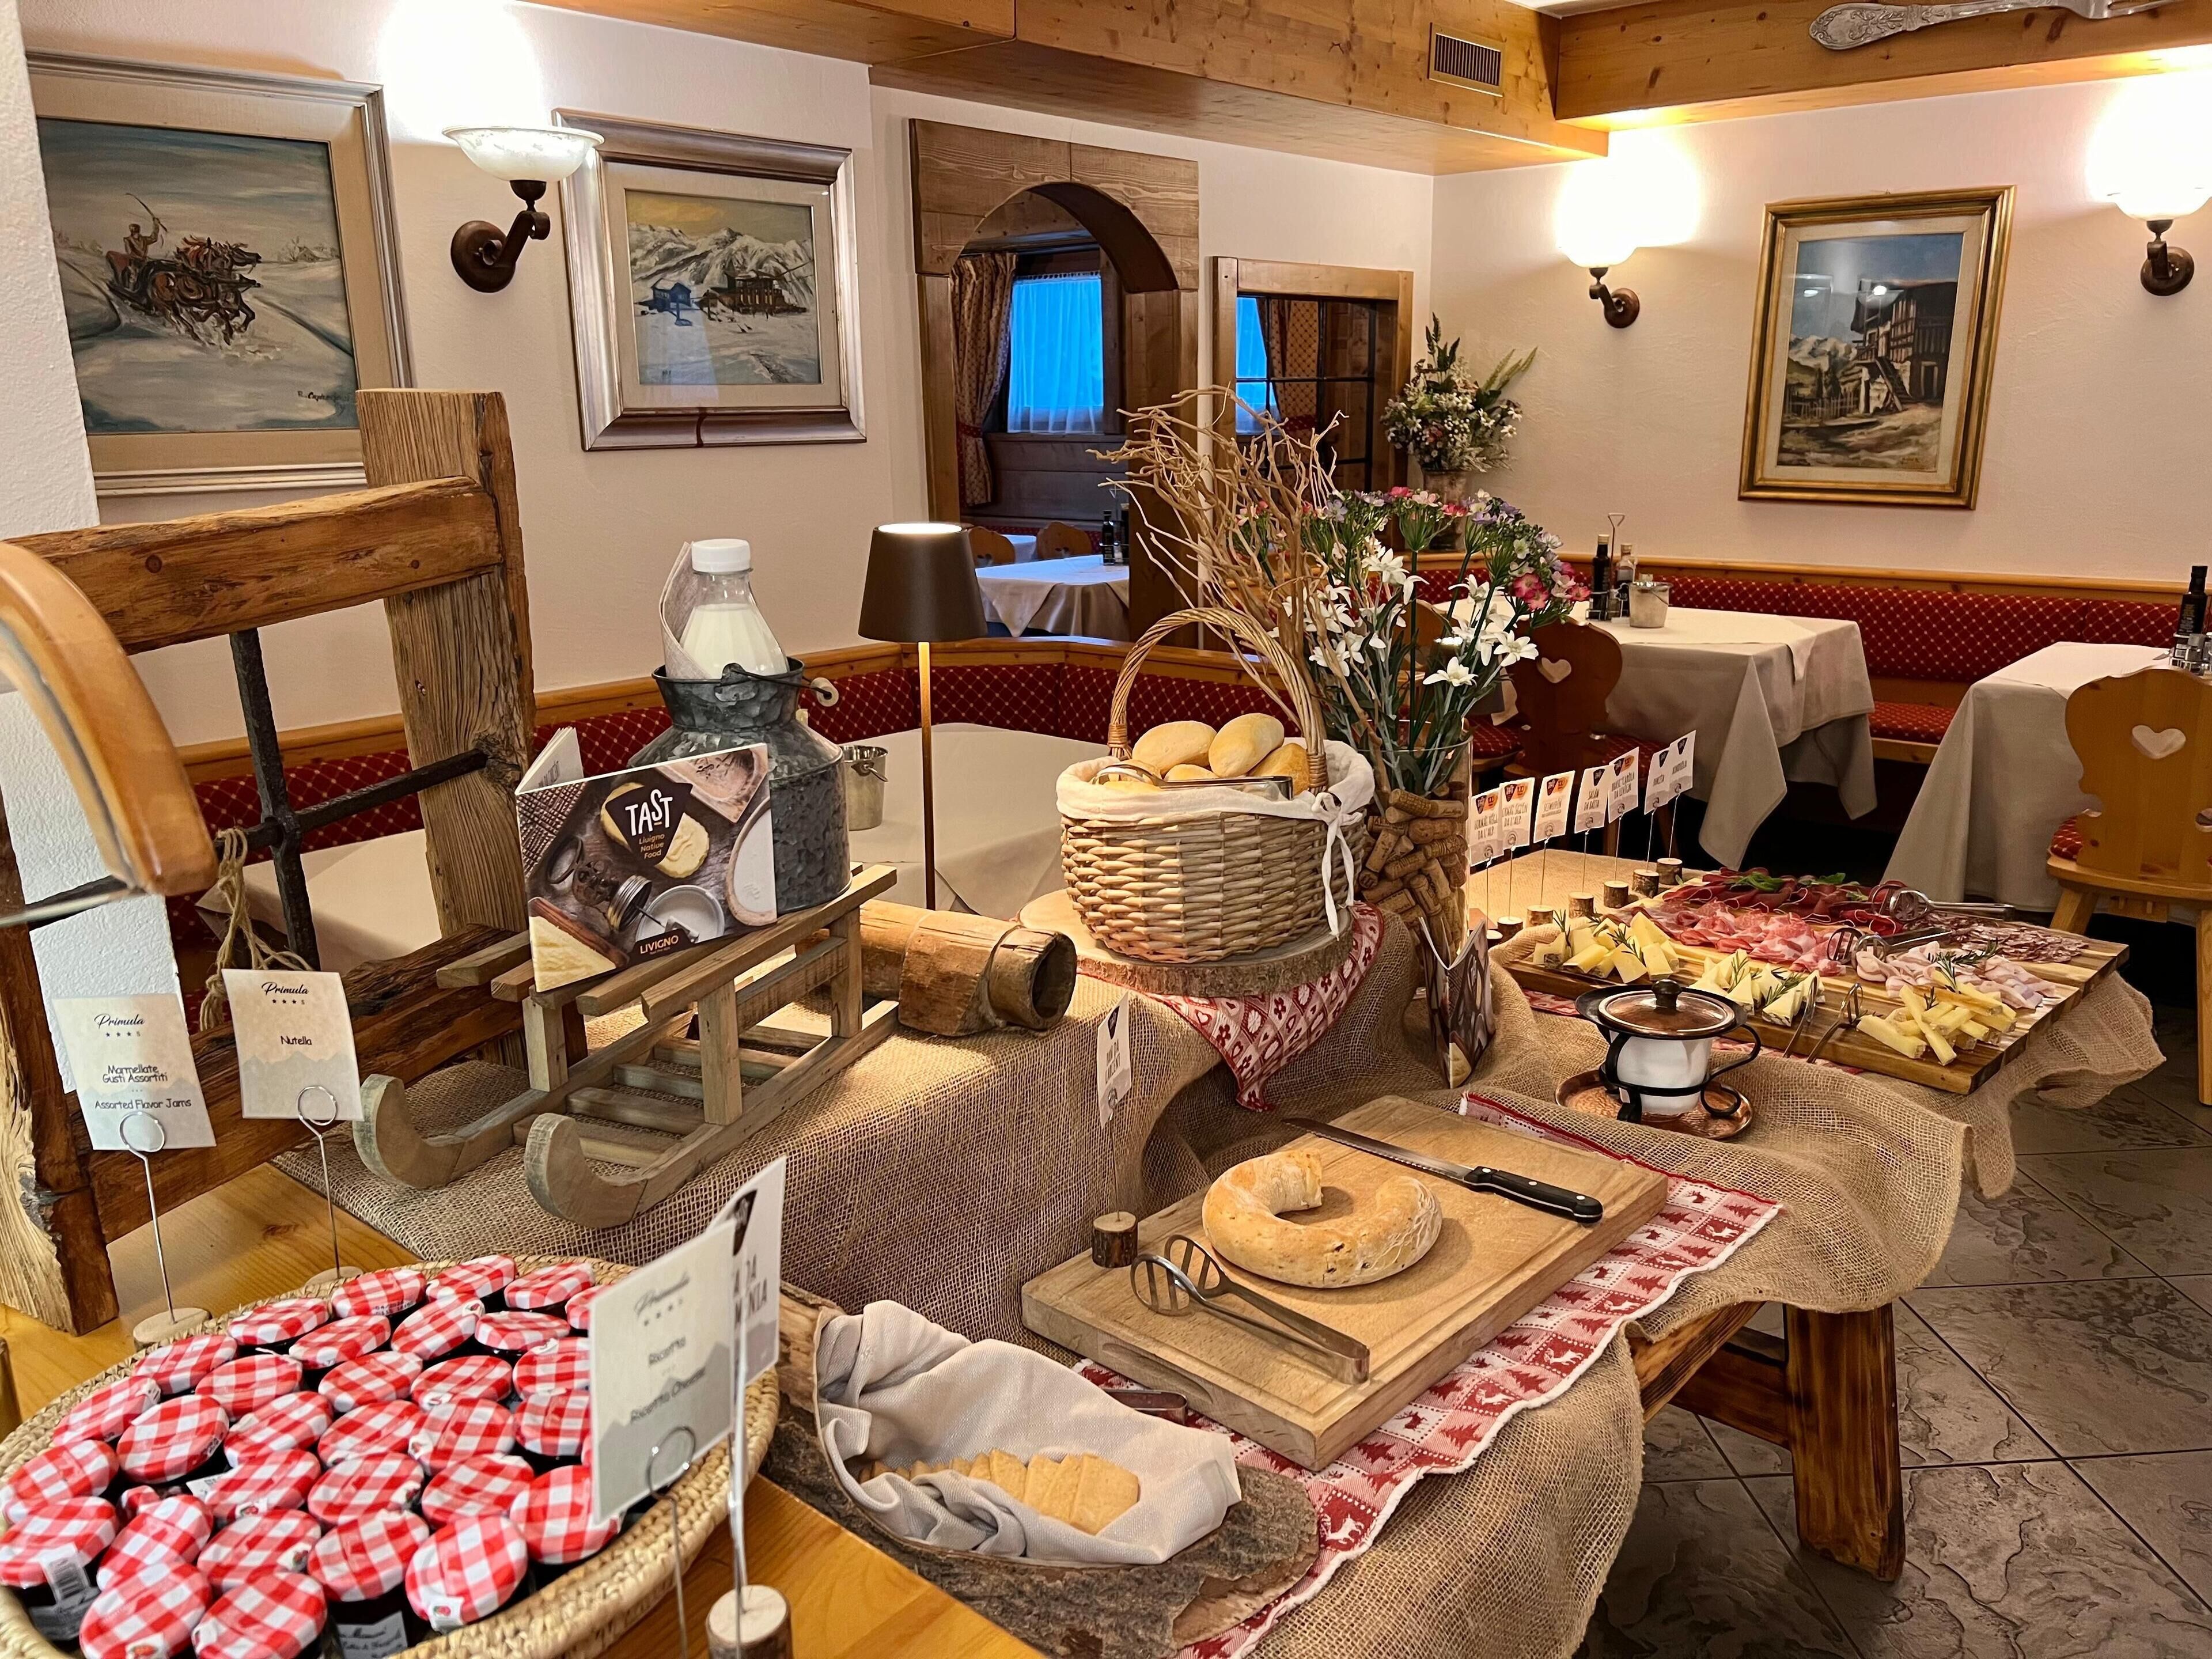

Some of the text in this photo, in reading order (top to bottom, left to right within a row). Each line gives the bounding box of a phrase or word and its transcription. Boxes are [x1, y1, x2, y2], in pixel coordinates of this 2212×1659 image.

[625, 789, 673, 836] TAST
[643, 849, 662, 860] Food
[639, 934, 679, 955] LIVIGNO
[261, 982, 309, 996] Primula
[94, 1013, 145, 1030] Primula
[280, 1035, 313, 1046] Nutella
[108, 1064, 160, 1075] Marmellate
[103, 1072, 168, 1084] Gusti Assortiti
[94, 1097, 192, 1109] Assorted Flavor Jams
